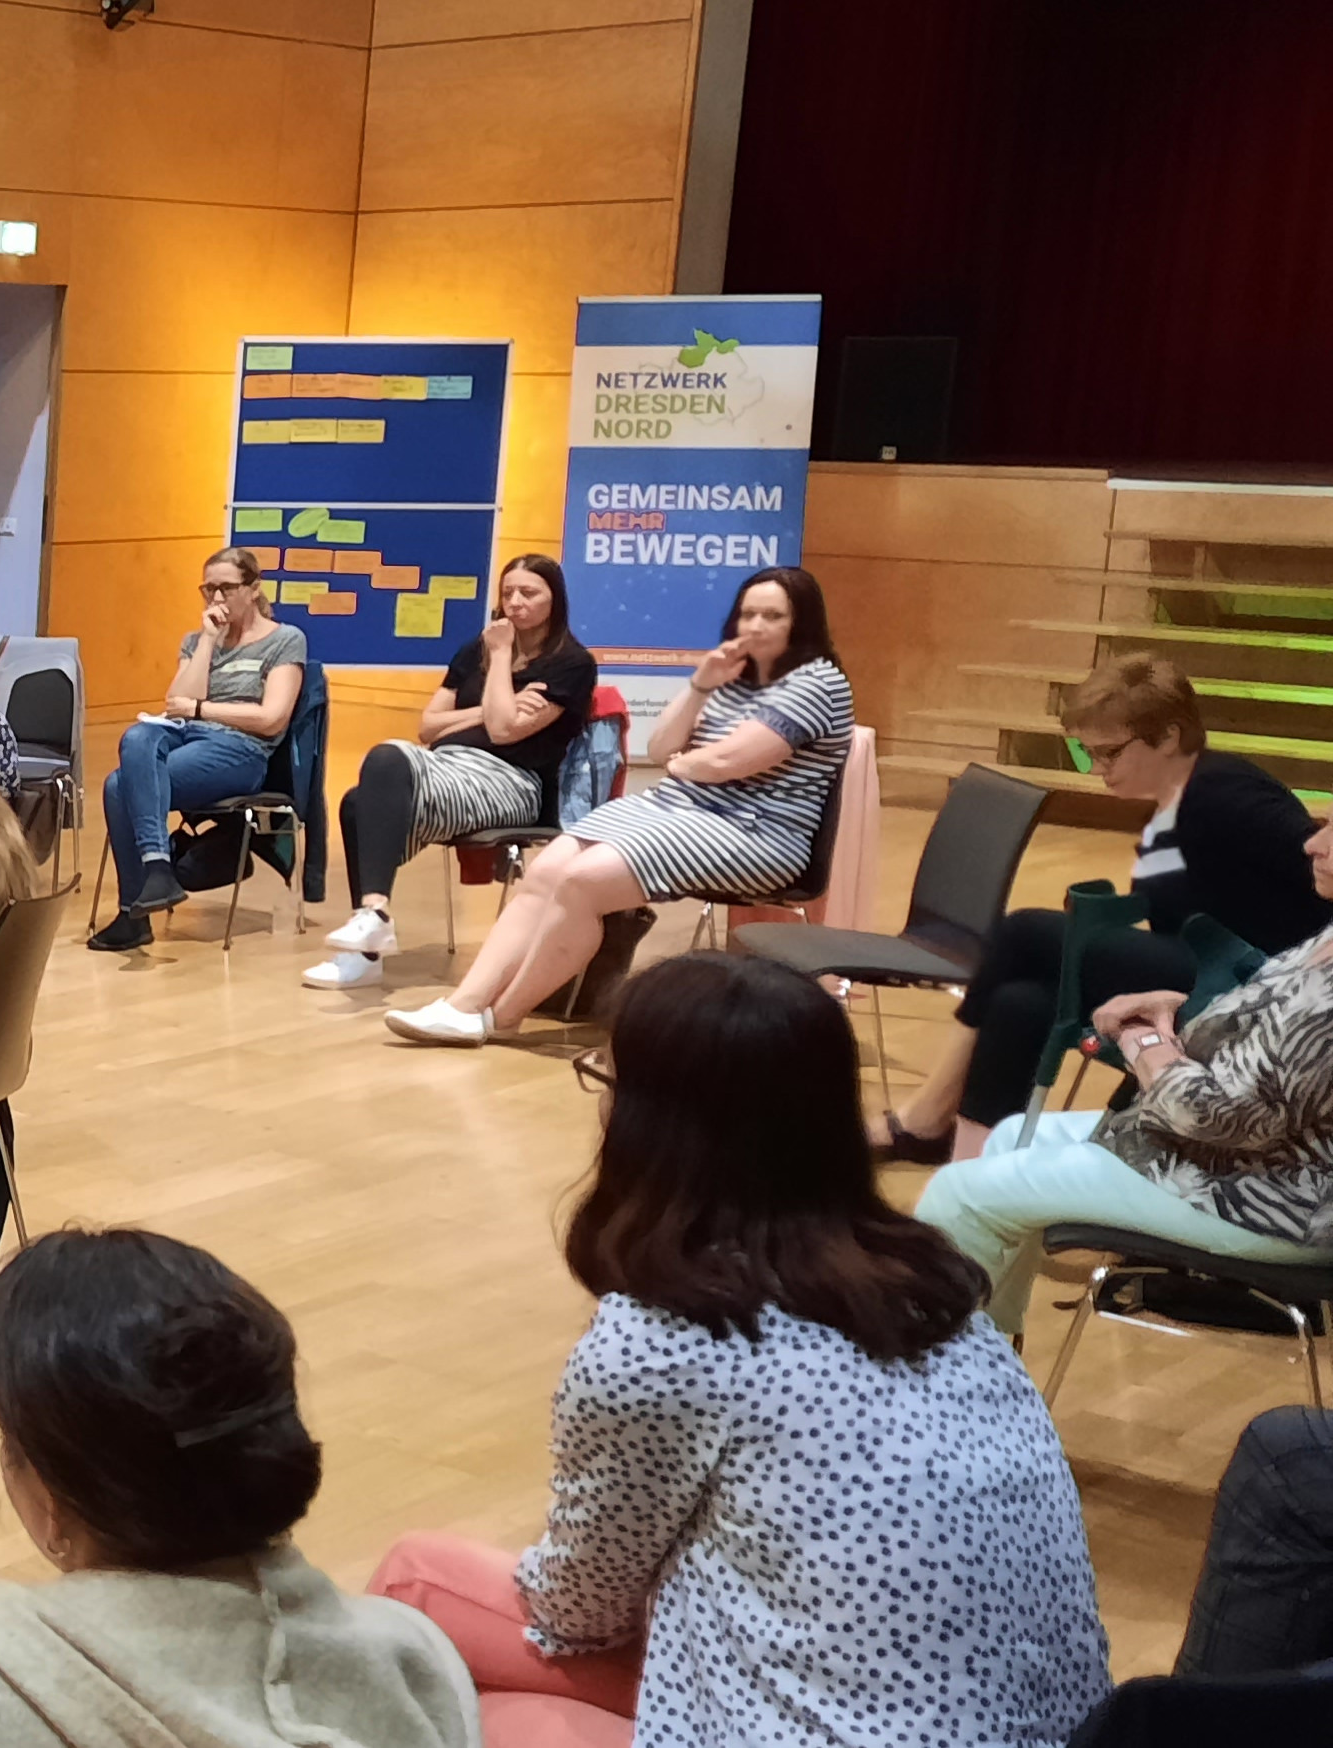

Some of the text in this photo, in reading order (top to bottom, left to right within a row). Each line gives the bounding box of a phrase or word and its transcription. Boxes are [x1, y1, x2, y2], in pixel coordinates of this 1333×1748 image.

[596, 372, 728, 390] NETZWERK
[594, 393, 726, 415] DRESDEN
[593, 418, 673, 440] NORD
[587, 483, 783, 511] GEMEINSAM
[587, 511, 666, 531] MEHR
[585, 533, 779, 567] BEWEGEN
